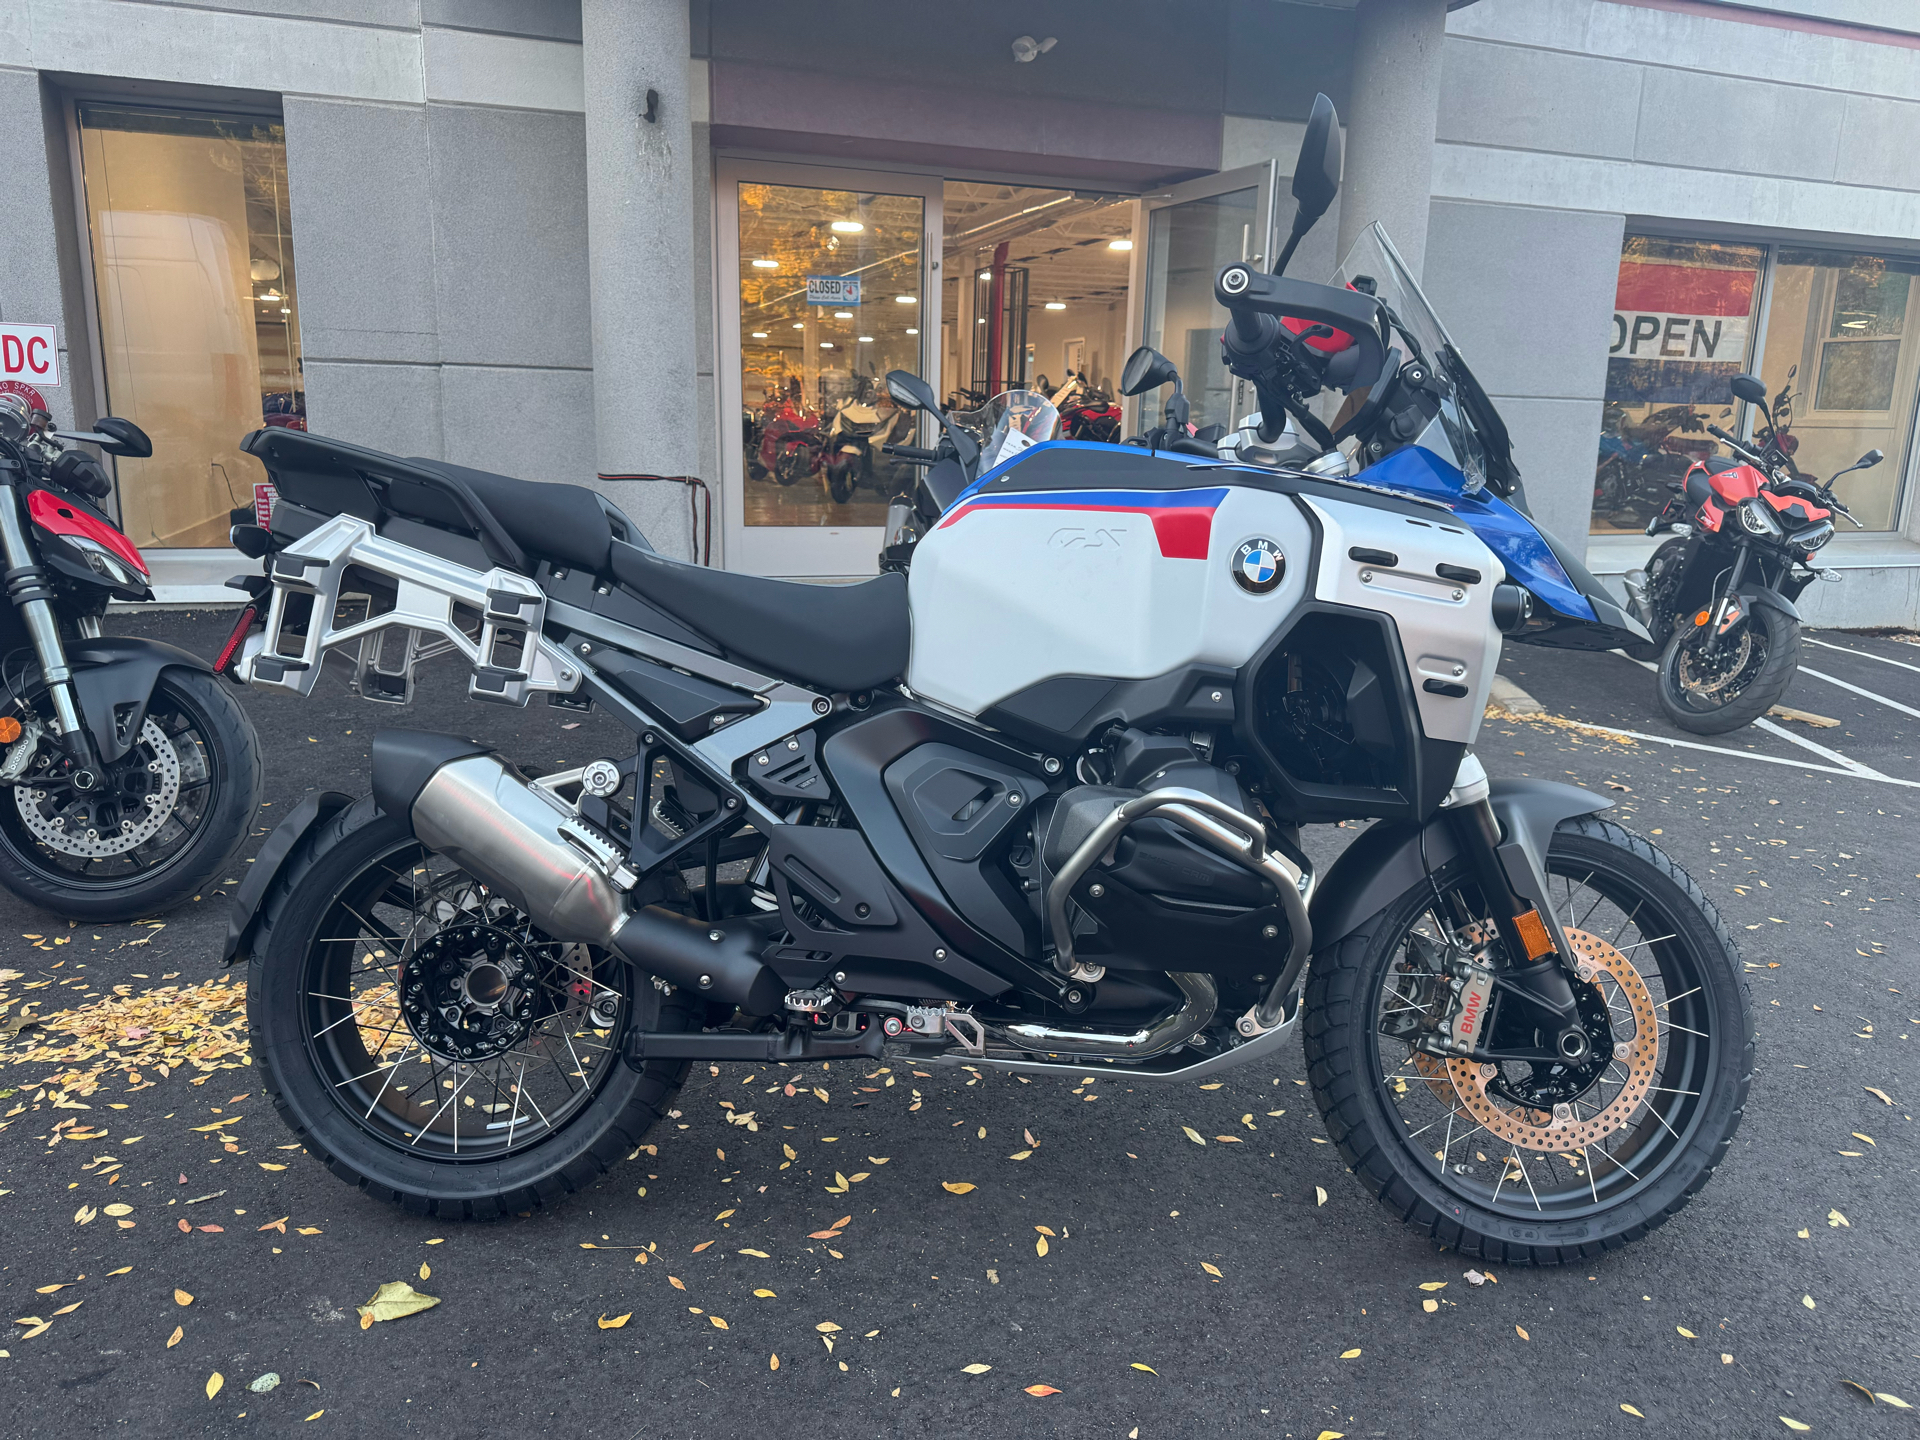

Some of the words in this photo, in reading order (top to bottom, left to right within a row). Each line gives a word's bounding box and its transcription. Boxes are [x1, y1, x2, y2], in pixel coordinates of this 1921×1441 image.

[809, 280, 841, 294] CLOSED
[1, 334, 50, 374] DC
[14, 382, 36, 397] SPKR
[1240, 540, 1284, 561] BMW
[8, 740, 29, 770] brembo
[1460, 991, 1482, 1034] BMW
